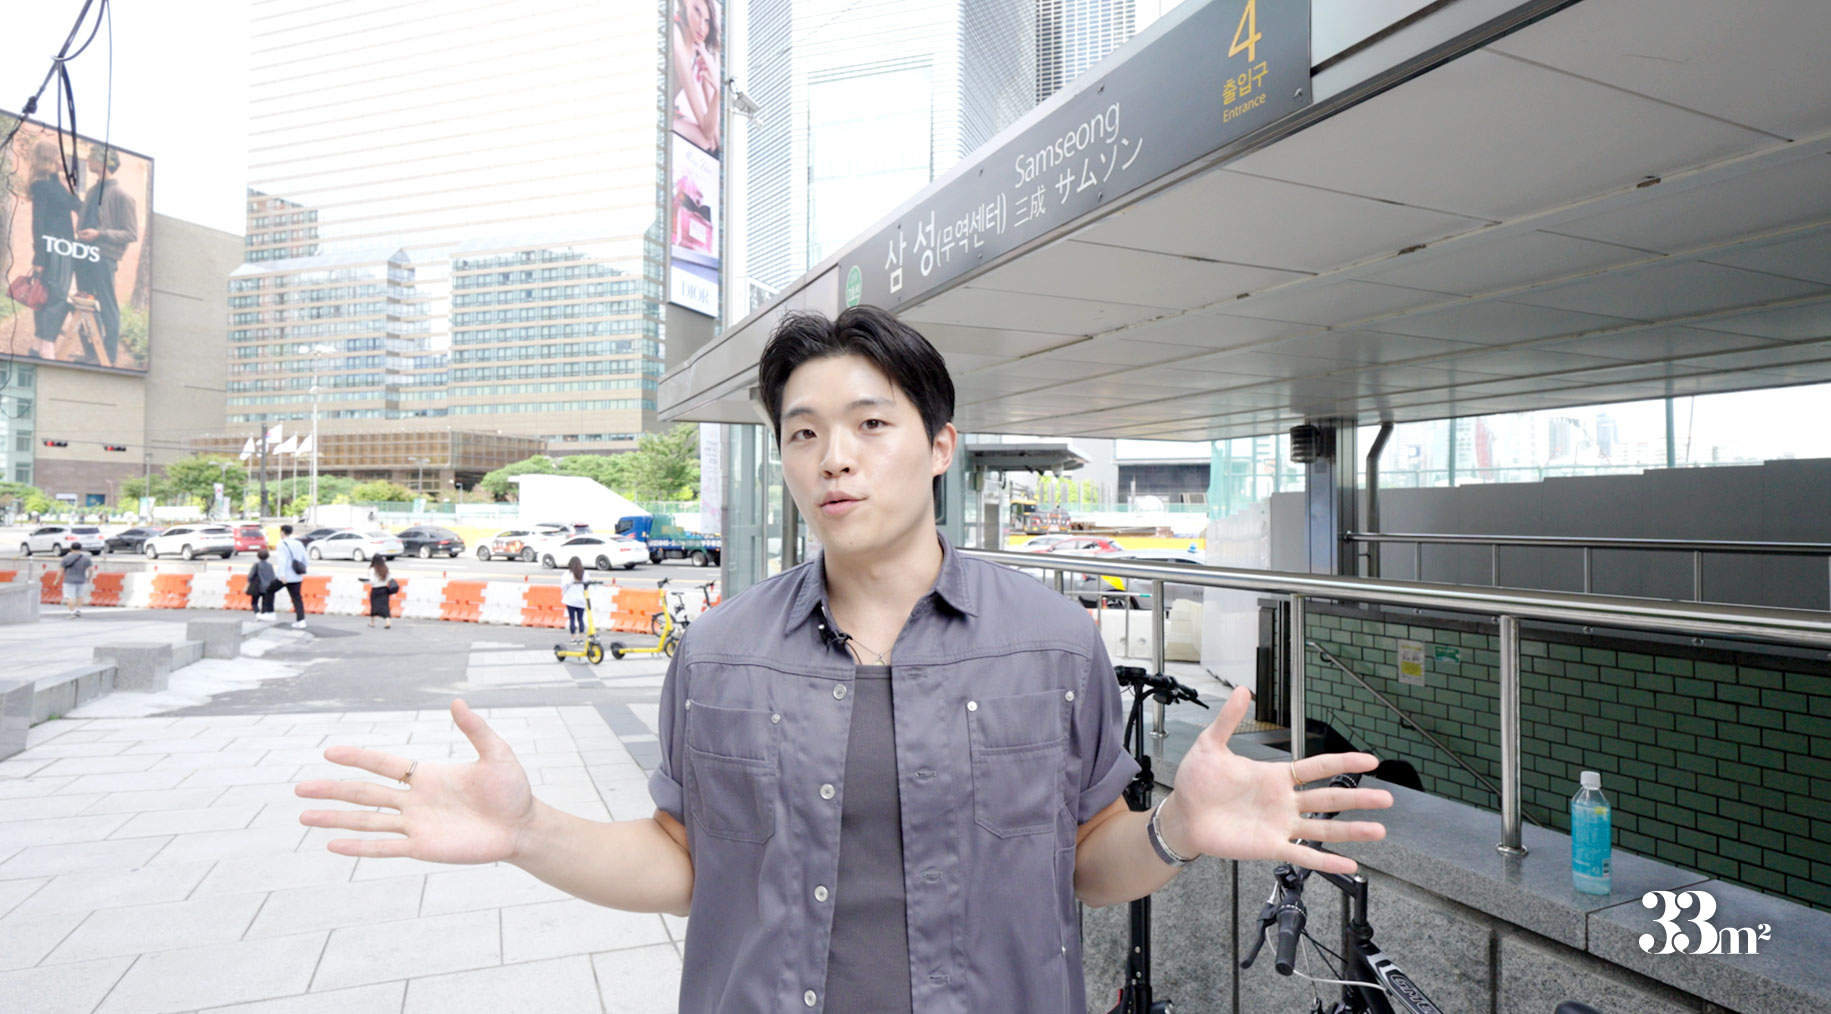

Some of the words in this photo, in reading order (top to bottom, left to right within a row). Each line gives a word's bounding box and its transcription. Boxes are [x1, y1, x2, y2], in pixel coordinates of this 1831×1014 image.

[1228, 0, 1262, 62] 4
[1222, 61, 1268, 105] 출입구
[1223, 93, 1267, 123] Entrance
[1015, 102, 1120, 188] Samseong
[1055, 137, 1144, 204] サムソン
[1014, 185, 1046, 228] 三成
[41, 234, 101, 263] TOD'S
[682, 280, 709, 305] DIOR
